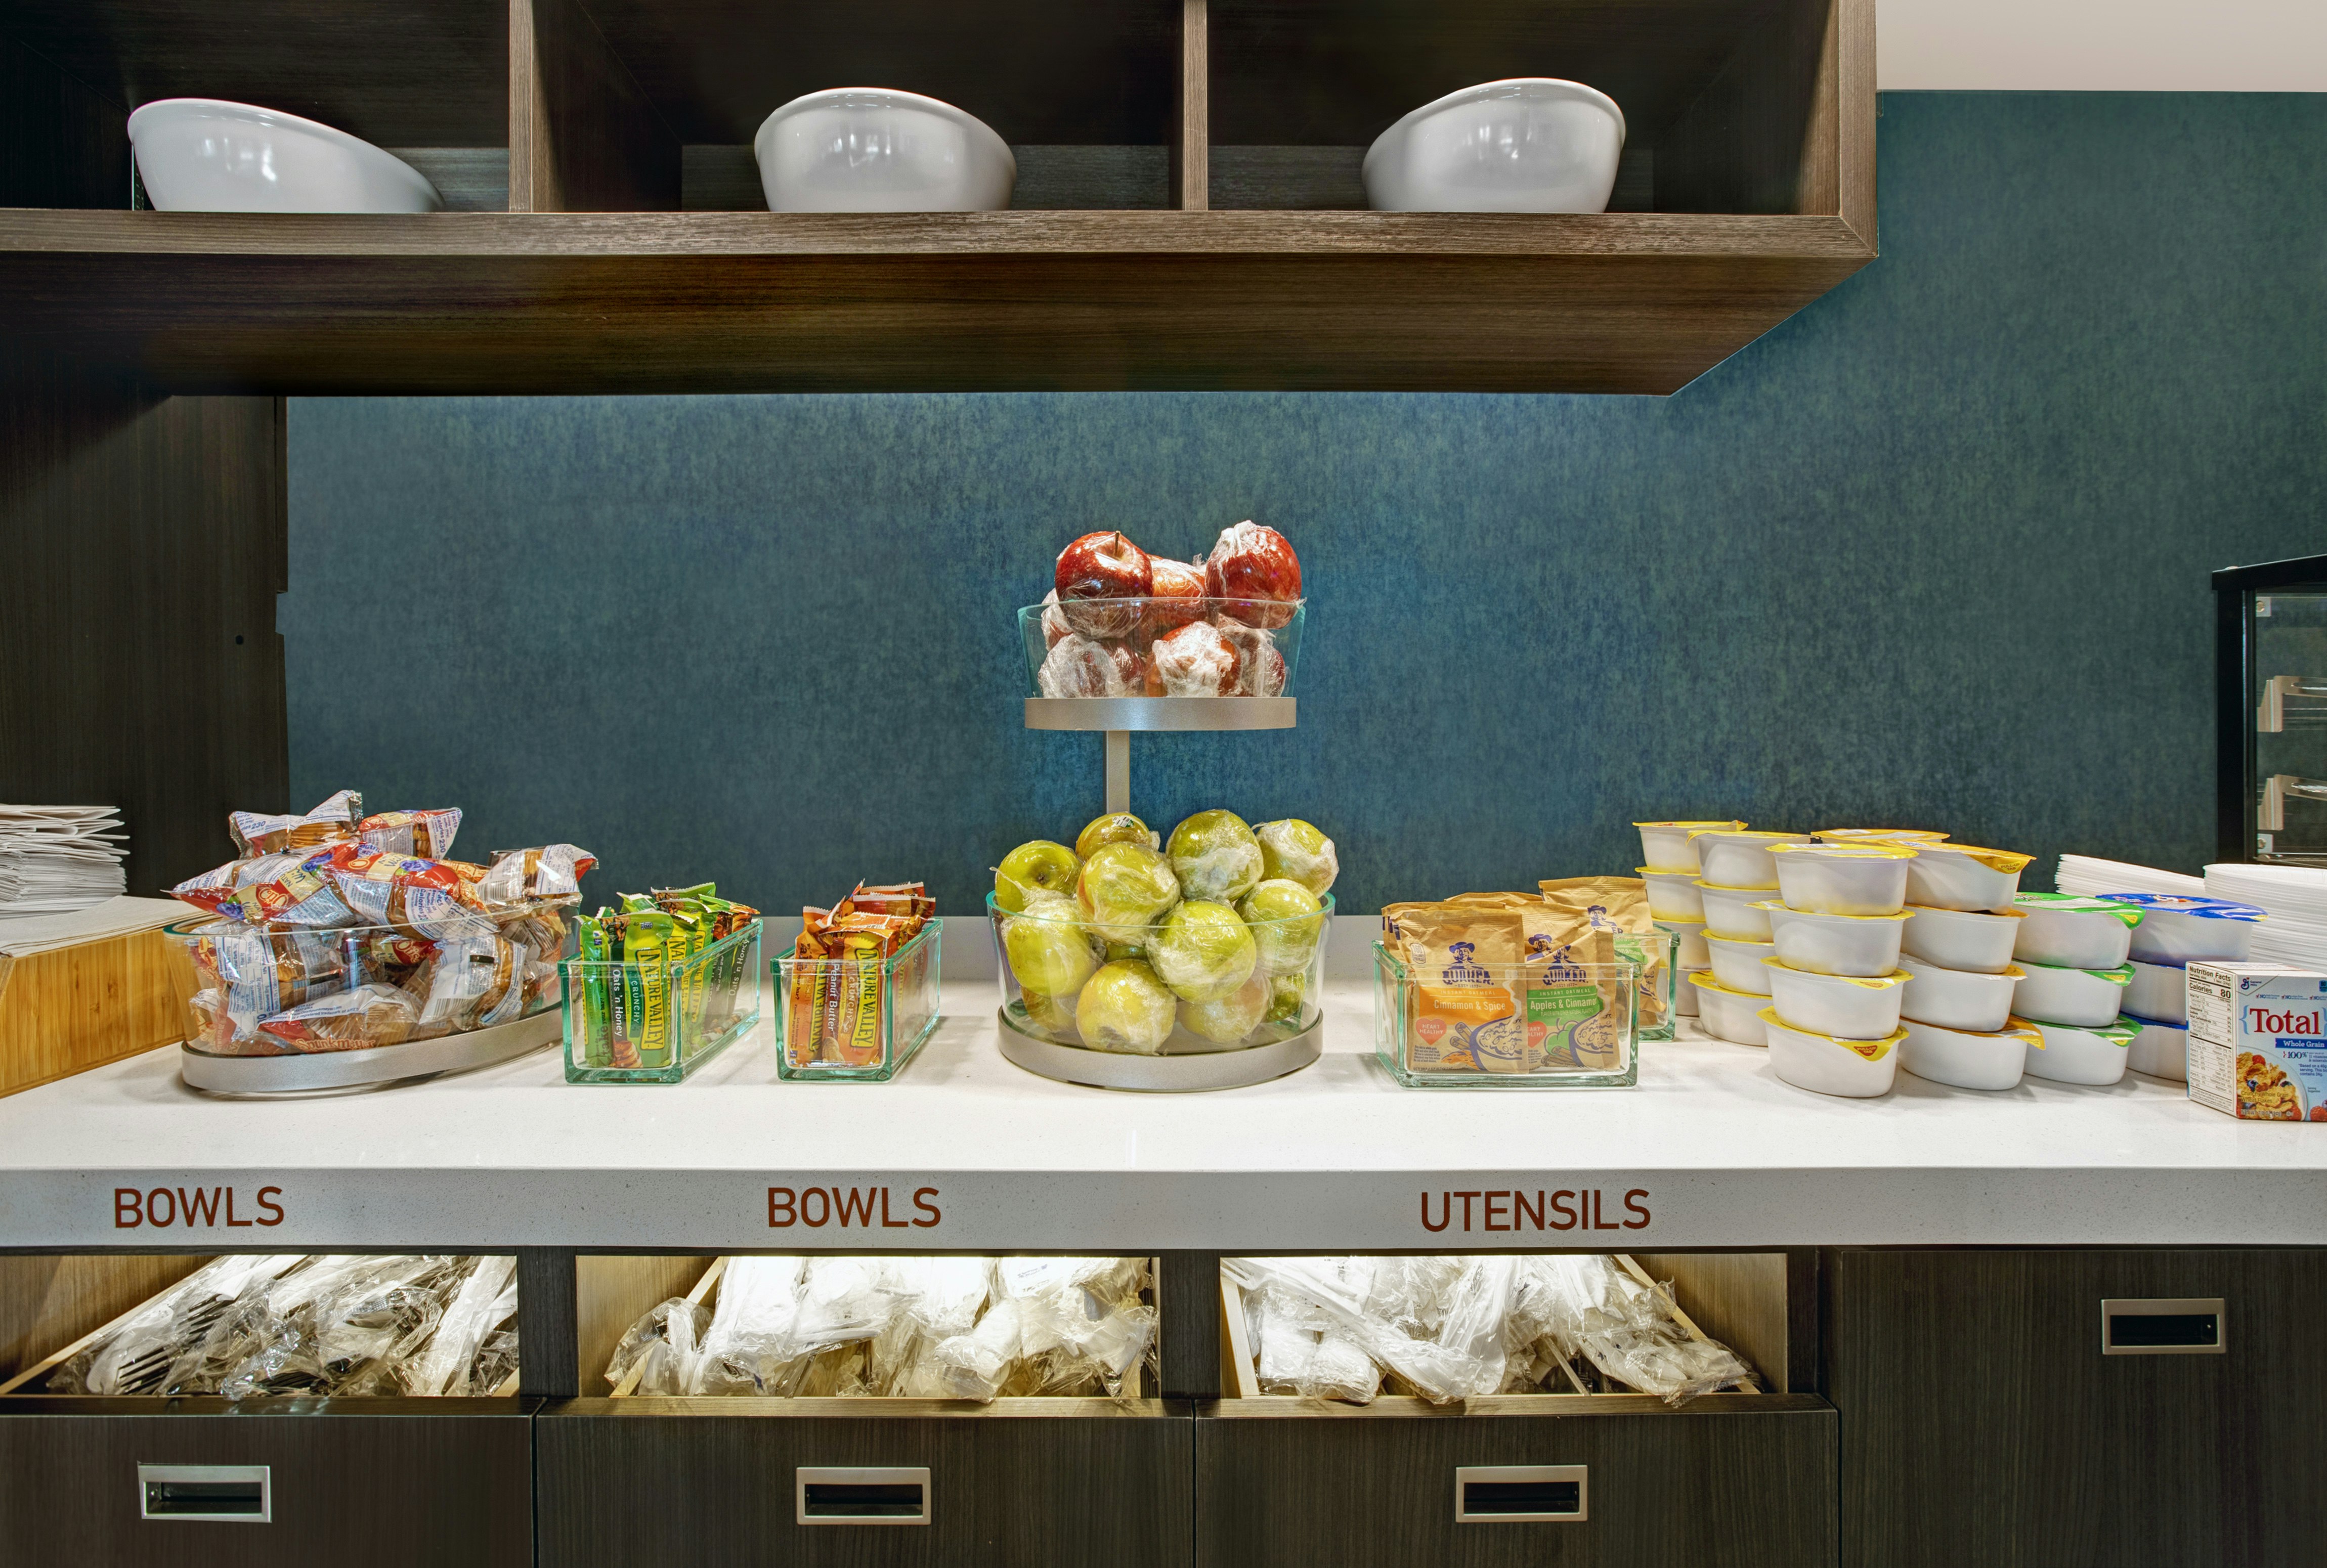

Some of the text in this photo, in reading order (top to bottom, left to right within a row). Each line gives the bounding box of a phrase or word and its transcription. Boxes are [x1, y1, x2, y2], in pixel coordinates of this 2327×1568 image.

[251, 820, 266, 830] 230
[436, 816, 445, 841] Calories
[612, 969, 621, 991] Oats
[640, 952, 662, 1003] NATURE
[728, 977, 740, 996] Oats
[736, 939, 750, 964] Honey
[2189, 966, 2231, 981] Nutrition Facts
[631, 980, 640, 1024] CRUNCHY
[828, 963, 840, 1032] Peanut Butter
[846, 976, 855, 1021] CRUNCHY
[854, 952, 878, 1044] NATURE VALLEY
[1434, 999, 1473, 1010] Cinnamon
[1484, 1001, 1505, 1012] Spice
[1530, 997, 1597, 1011] Apples & Cinnamo
[2189, 982, 2231, 999] Calories 80
[614, 1006, 624, 1037] Honey
[644, 1000, 664, 1046] VALLEY
[2250, 1008, 2321, 1034] Total
[295, 1038, 376, 1051] Spunkmeyer
[114, 1186, 284, 1228] BOWLS
[768, 1187, 941, 1228] BOWLS
[1421, 1189, 1651, 1232] UTENSILS
